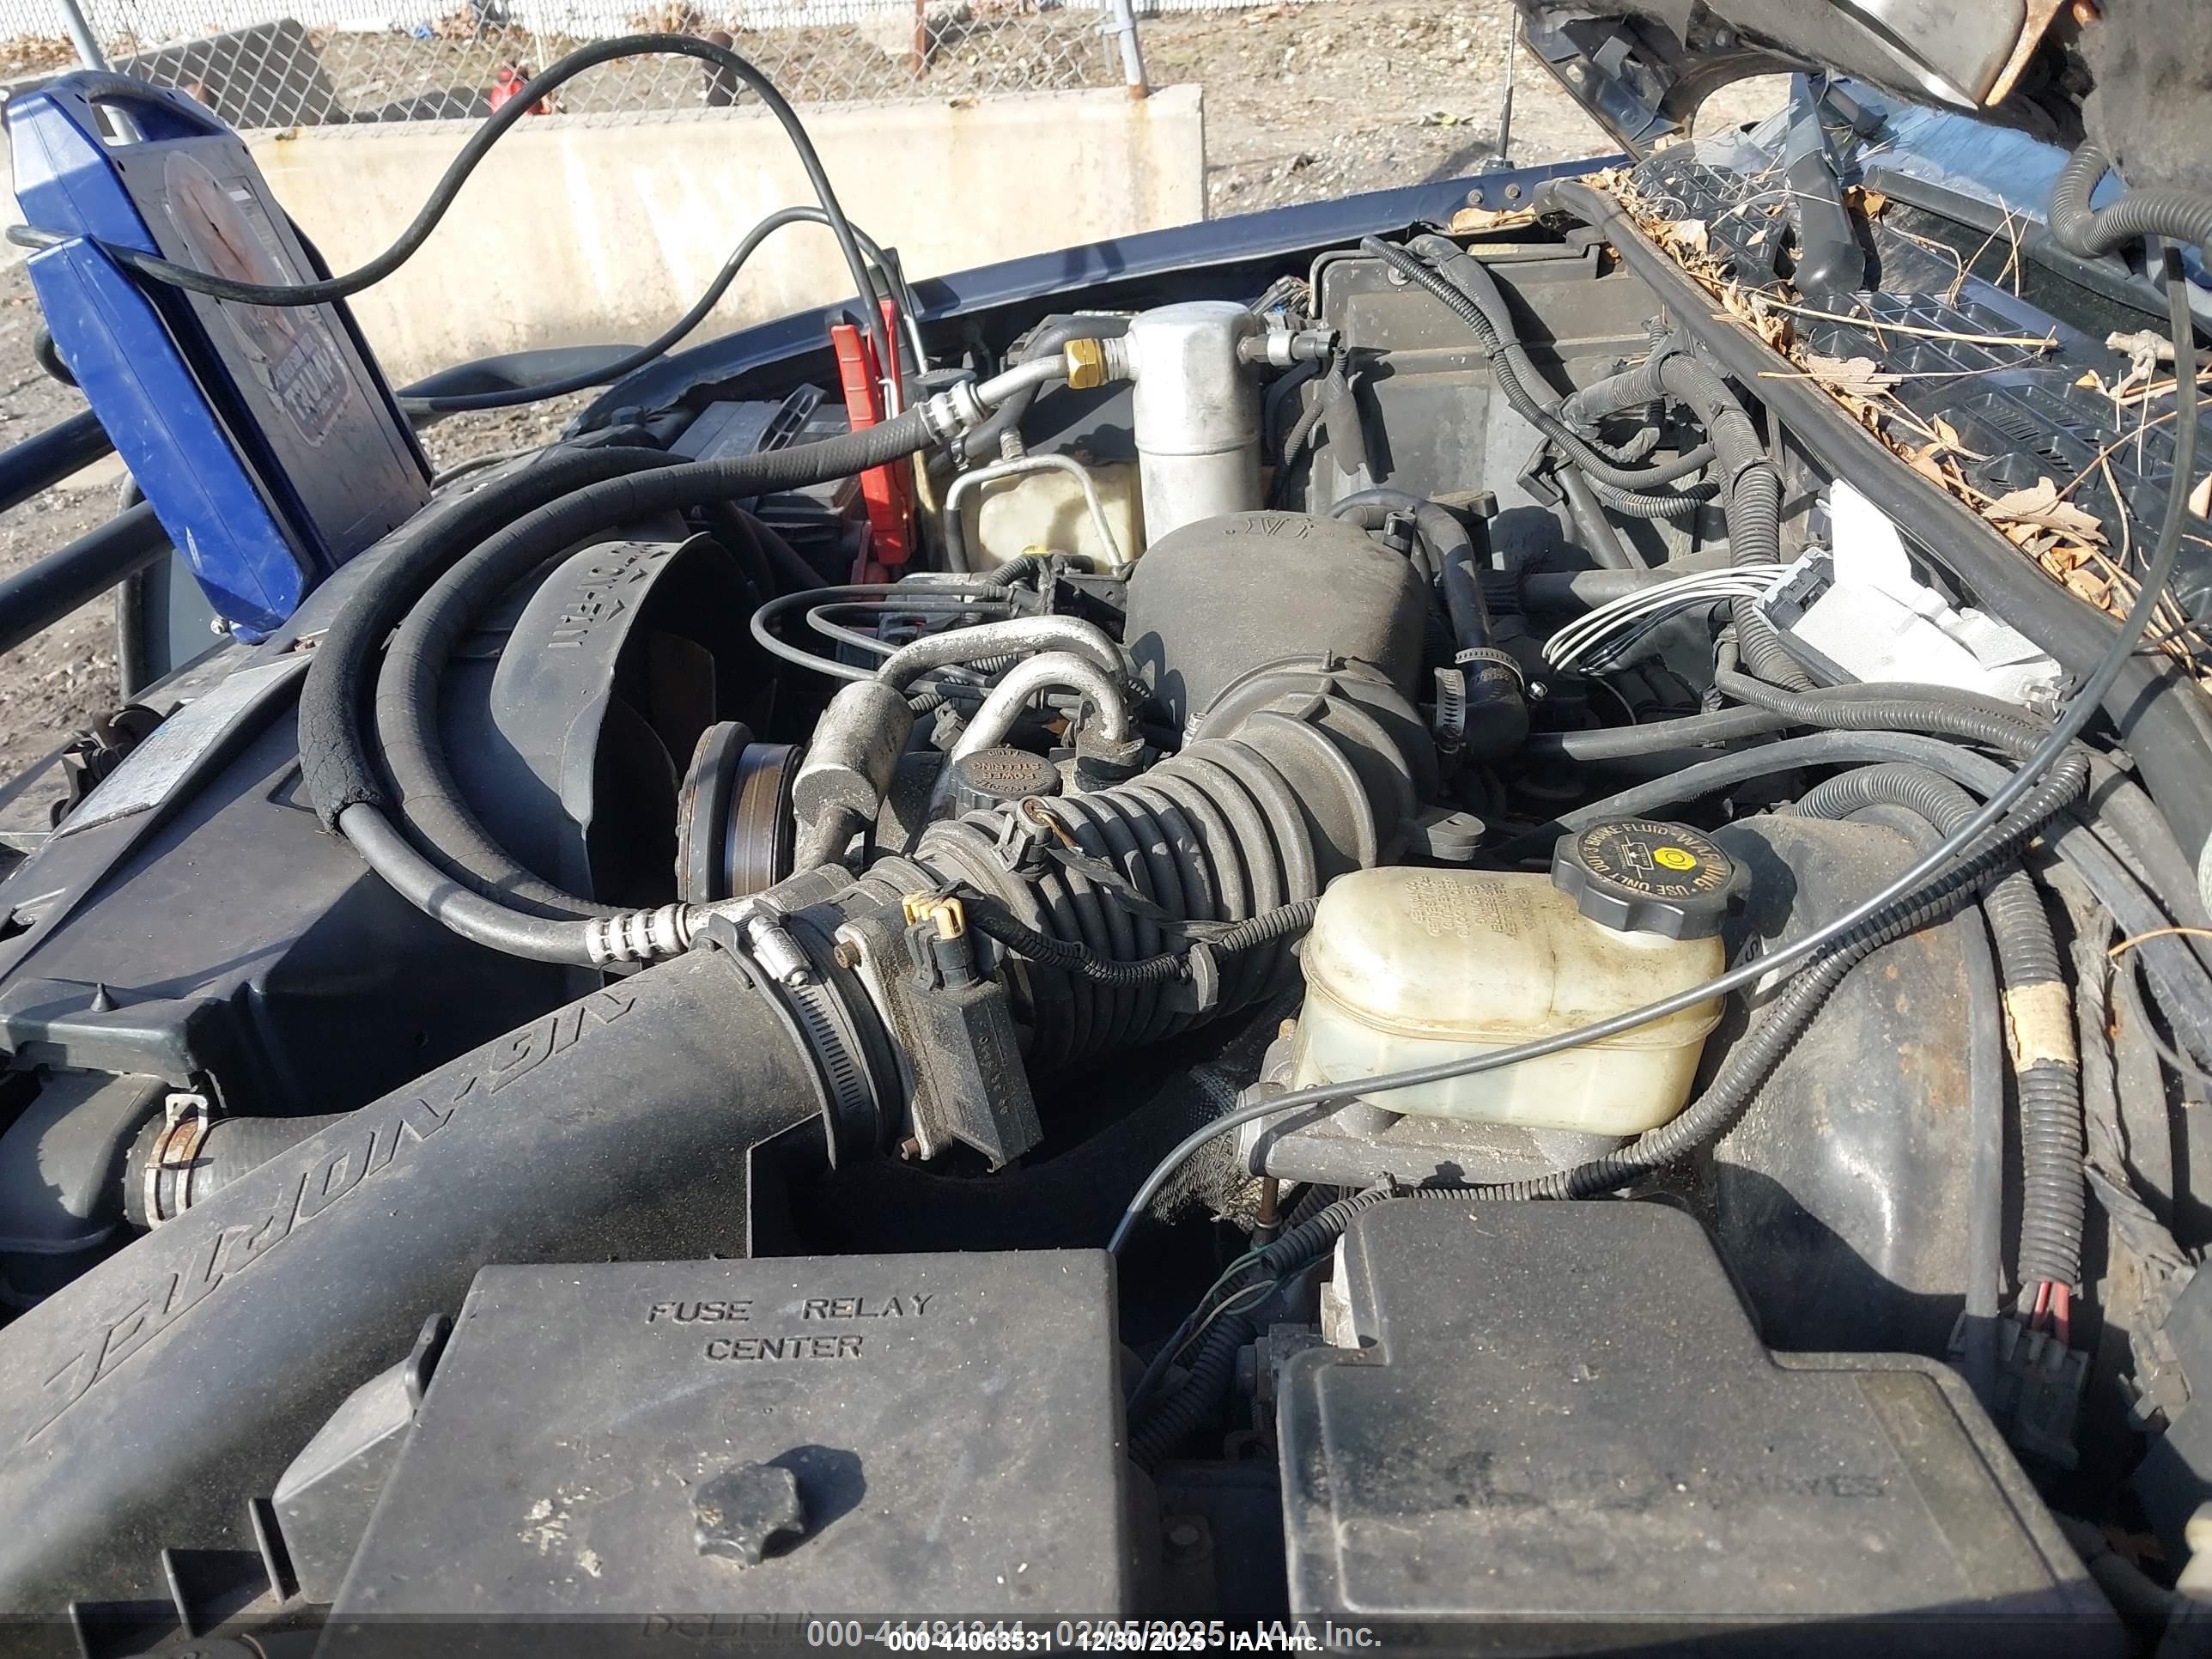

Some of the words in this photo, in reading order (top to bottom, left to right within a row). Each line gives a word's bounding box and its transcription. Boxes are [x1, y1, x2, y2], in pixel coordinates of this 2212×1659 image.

[1584, 824, 1622, 847] BRAKE
[1622, 823, 1668, 835] FLUID
[1608, 872, 1650, 890] ONLY
[1656, 884, 1690, 896] USE
[646, 1298, 754, 1324] FUSE
[801, 1291, 933, 1321] RELAY
[704, 1334, 864, 1362] CENTER
